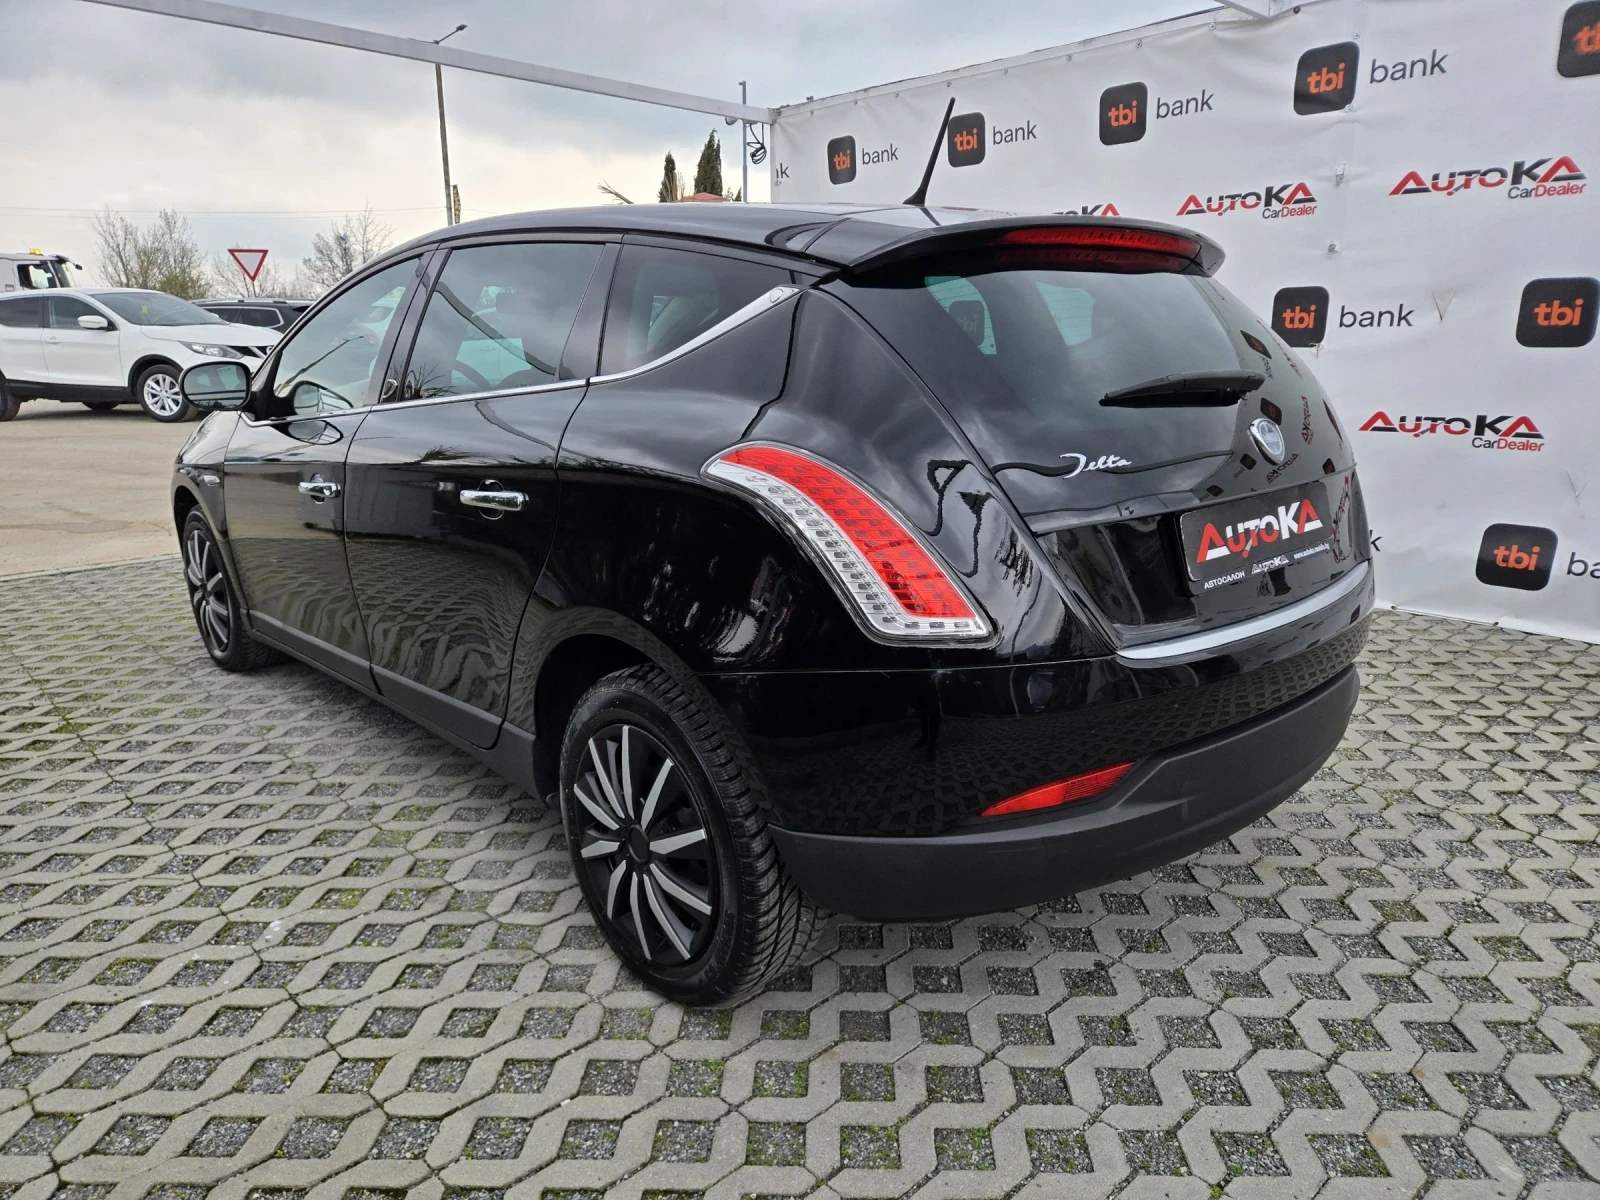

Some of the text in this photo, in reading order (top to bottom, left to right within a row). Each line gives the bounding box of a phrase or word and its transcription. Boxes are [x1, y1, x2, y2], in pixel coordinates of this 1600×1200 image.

[1307, 49, 1448, 94] tbi bank
[1108, 89, 1214, 128] tbi bank
[954, 120, 1037, 151] tbi bank
[833, 143, 899, 171] tbi bank
[1388, 155, 1588, 197] AUTOKA
[1507, 182, 1588, 200] CarDealer
[1176, 181, 1318, 217] AUTOKA
[1262, 204, 1318, 219] CarDealer
[1282, 303, 1415, 329] tbi bank
[1532, 298, 1584, 327] tbi
[1357, 410, 1545, 439] AUTOKA
[1471, 436, 1545, 452] CarDealer
[1060, 453, 1134, 480] Delta
[1196, 498, 1324, 563] AUTOKA
[1203, 554, 1290, 590] АВТОСАЛОН AUTOKA
[1493, 544, 1600, 579] tbi ba
